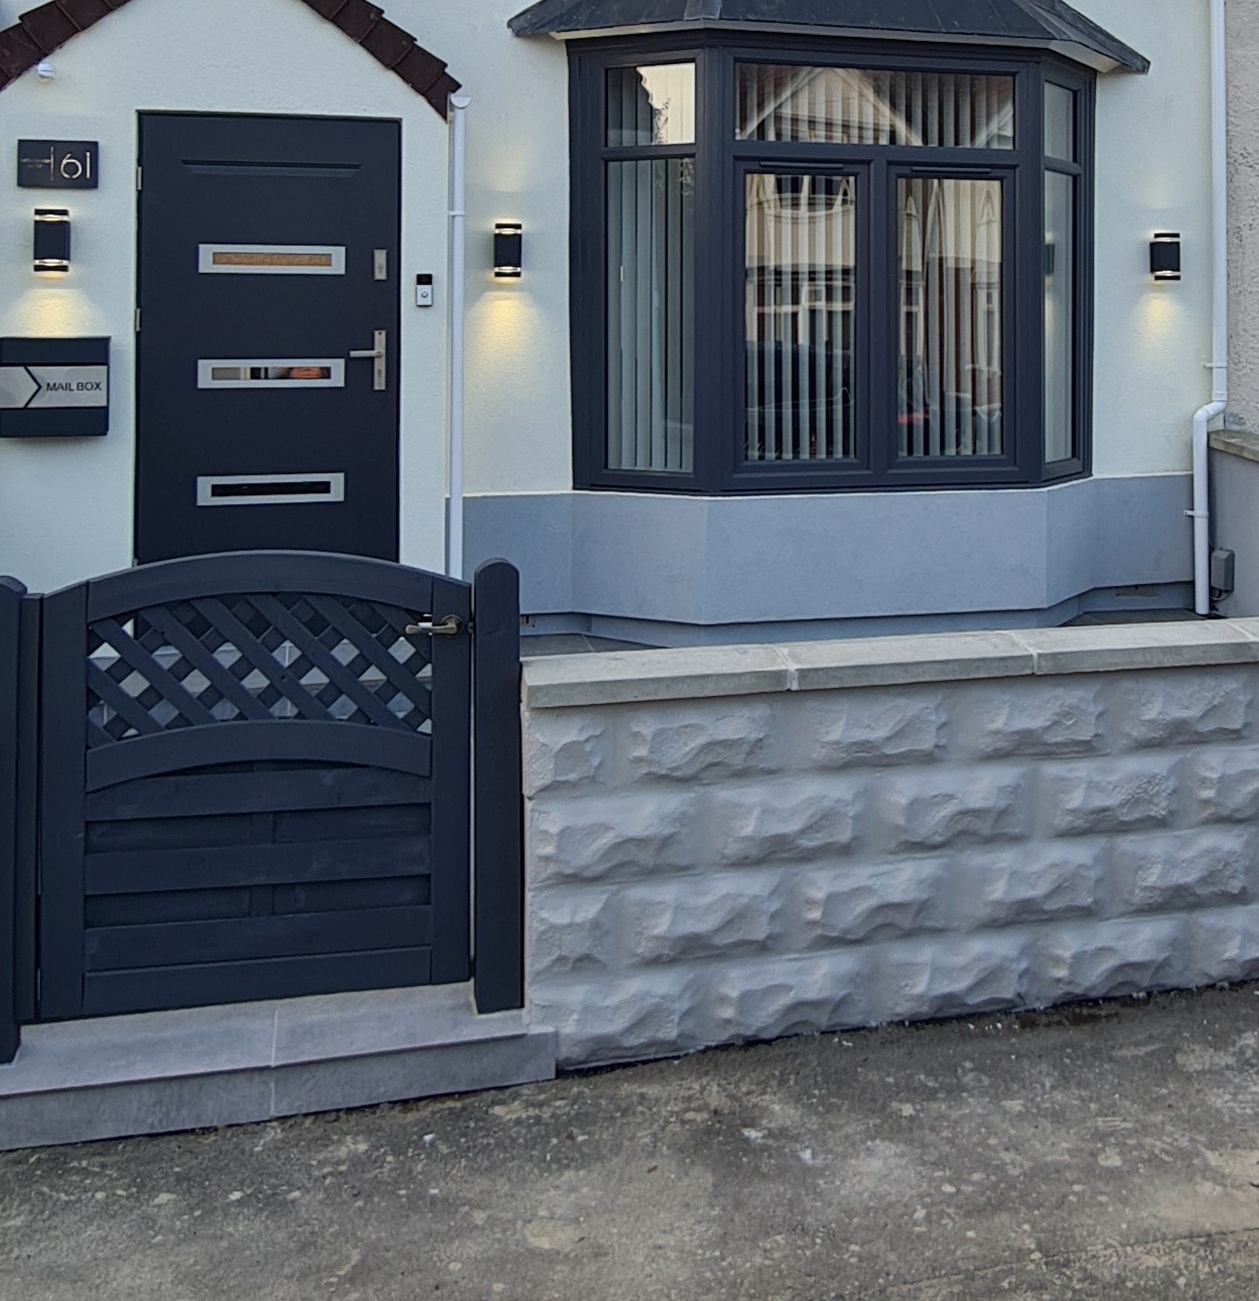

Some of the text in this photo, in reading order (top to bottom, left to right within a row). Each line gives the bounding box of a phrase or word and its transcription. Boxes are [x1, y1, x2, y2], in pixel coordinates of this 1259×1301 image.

[60, 151, 91, 179] 61
[46, 382, 102, 391] MAIL BOX
